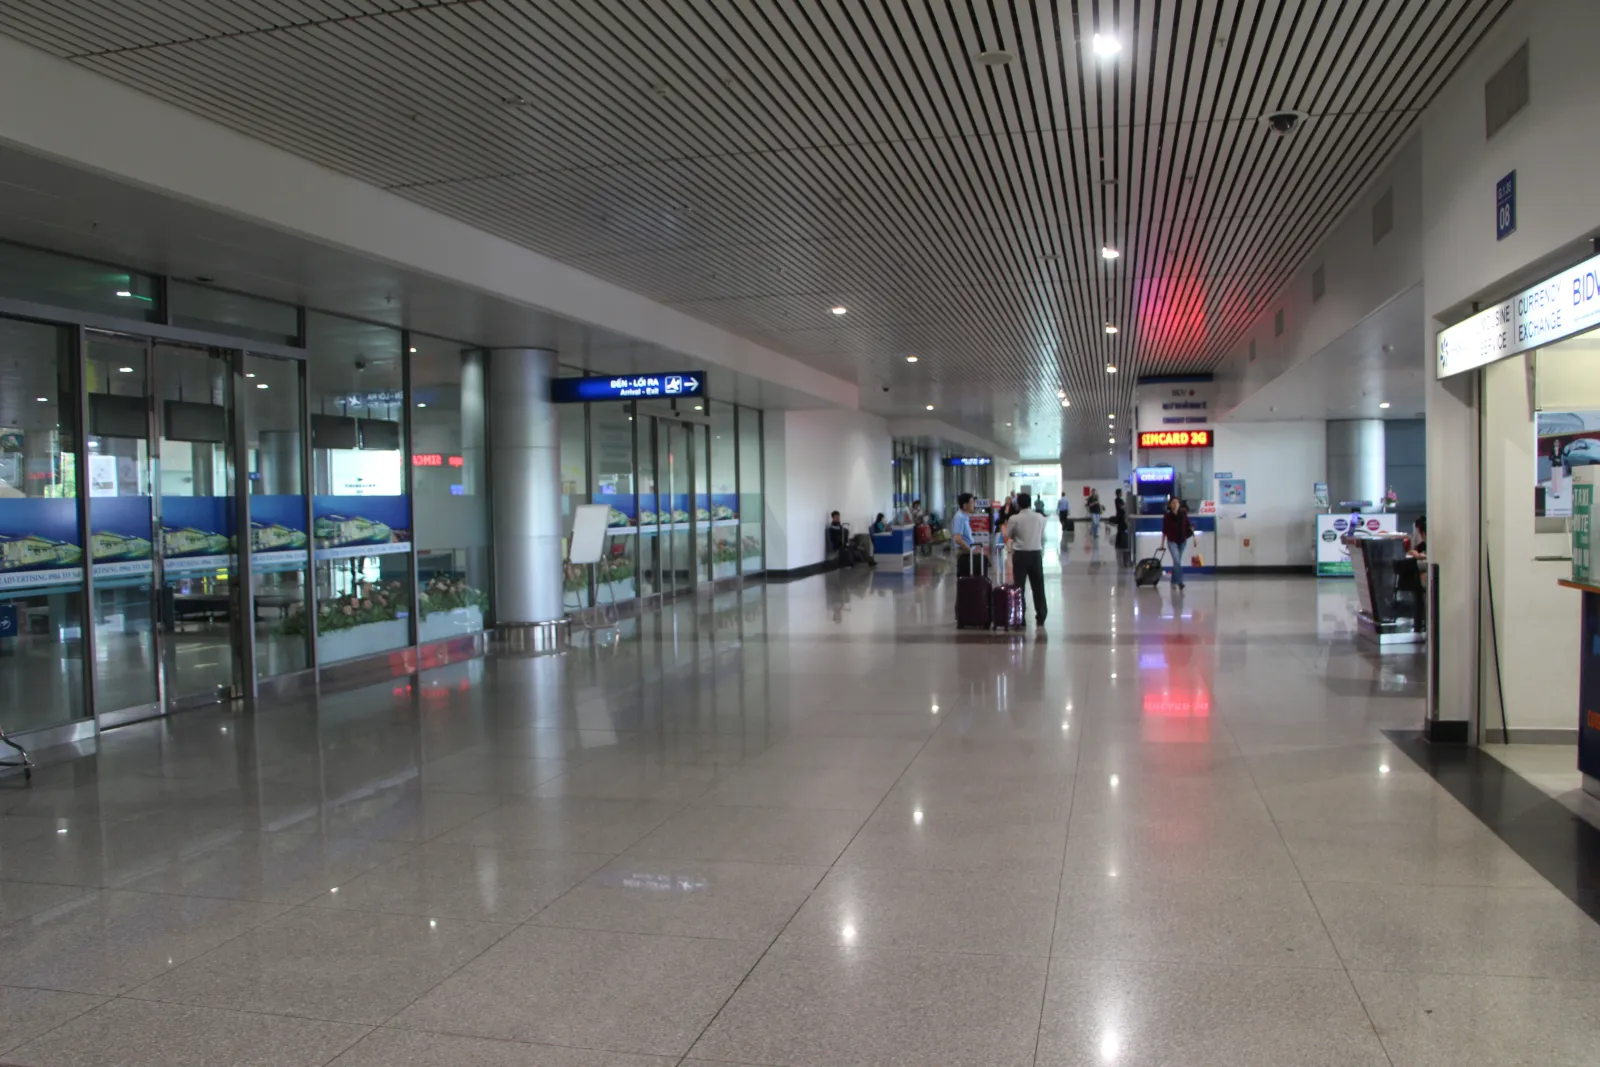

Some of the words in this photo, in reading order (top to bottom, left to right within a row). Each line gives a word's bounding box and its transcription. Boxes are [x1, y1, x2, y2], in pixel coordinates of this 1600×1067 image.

[1499, 202, 1510, 230] 08
[1517, 280, 1562, 317] CURRENCY
[1518, 309, 1562, 342] EXCHANGE
[646, 387, 660, 396] Exit
[647, 378, 660, 387] RA
[1141, 431, 1189, 447] SIMCARD
[1190, 431, 1208, 445] 3G
